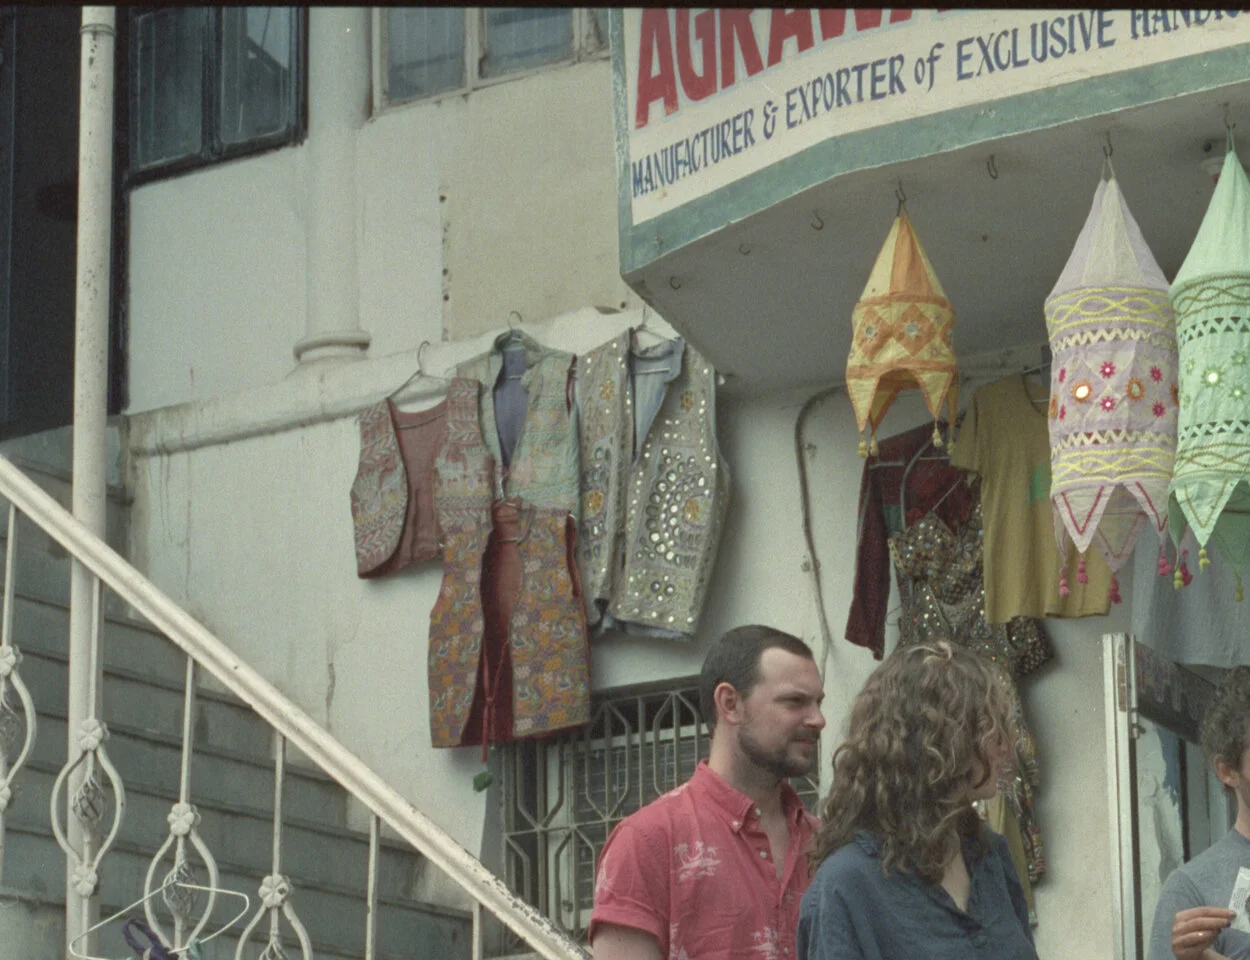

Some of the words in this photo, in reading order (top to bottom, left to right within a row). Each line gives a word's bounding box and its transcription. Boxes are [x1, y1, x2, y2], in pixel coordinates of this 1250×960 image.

[631, 109, 756, 198] MANUFACTURER
[762, 100, 779, 140] &
[785, 54, 906, 130] EXPORTER
[914, 42, 945, 92] of
[956, 9, 1116, 81] EXCLUSIVE
